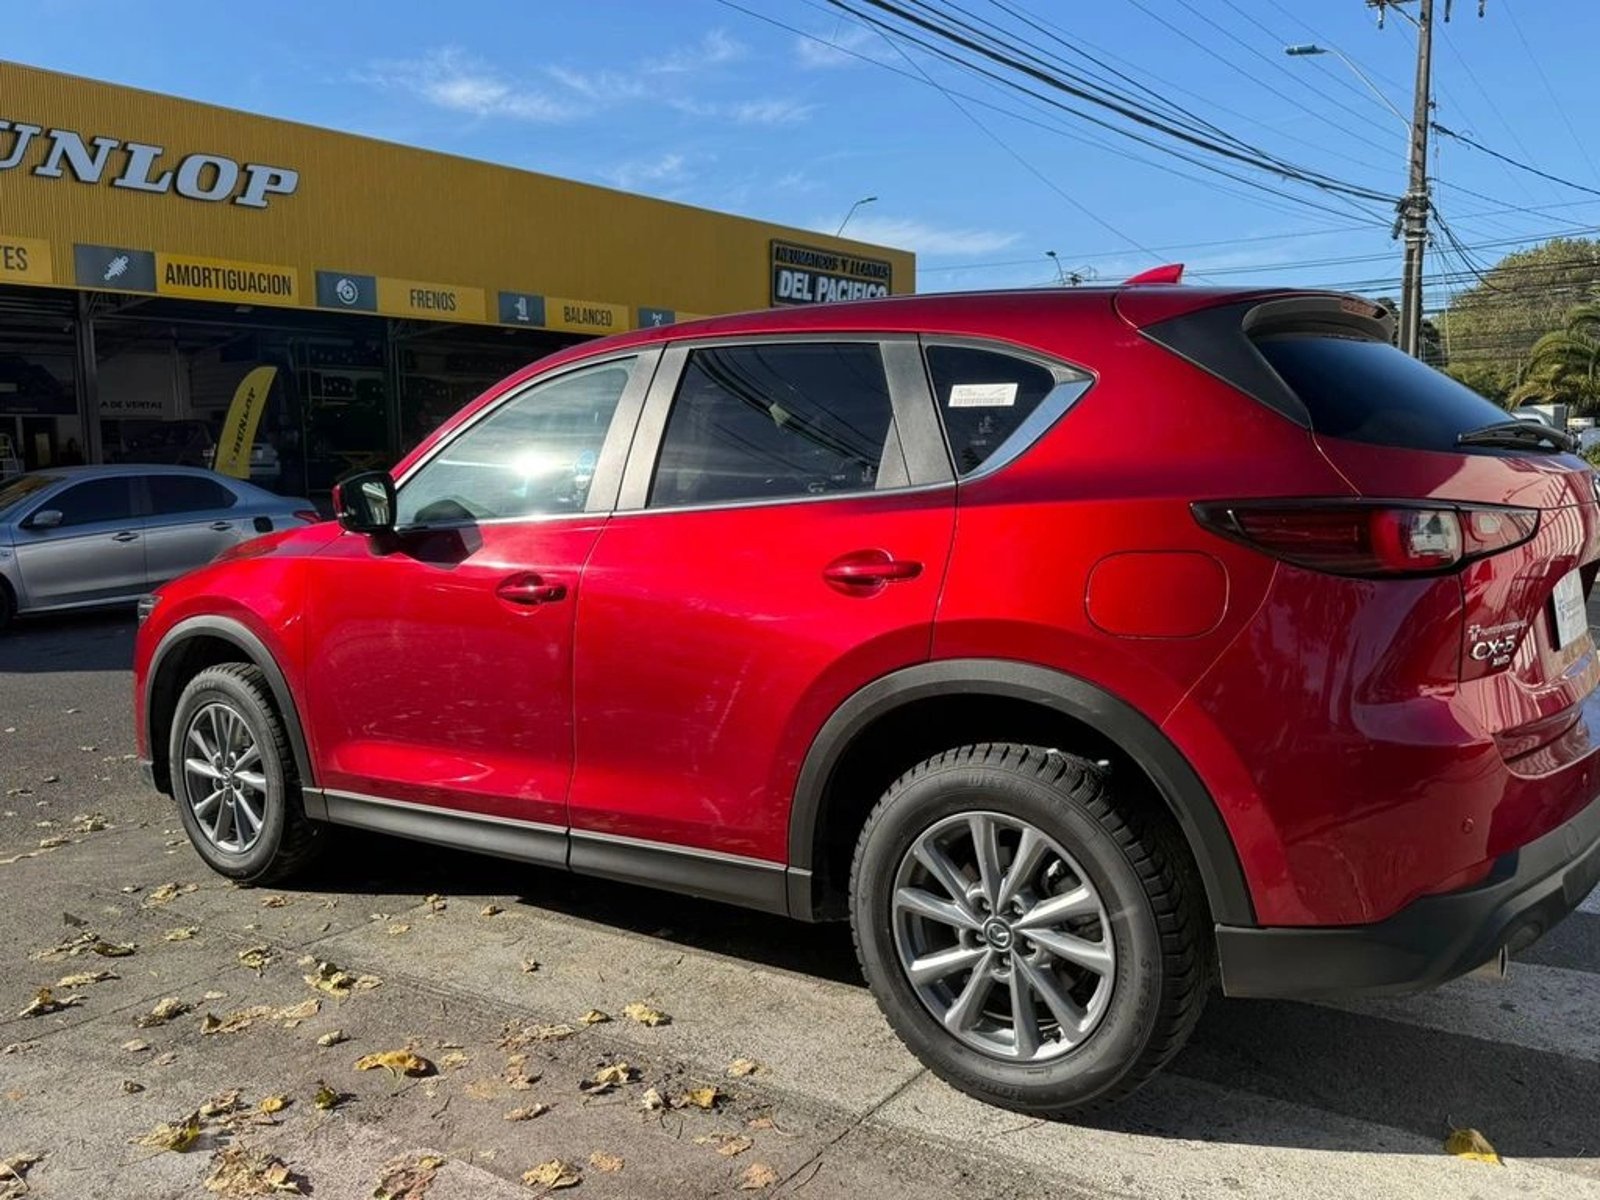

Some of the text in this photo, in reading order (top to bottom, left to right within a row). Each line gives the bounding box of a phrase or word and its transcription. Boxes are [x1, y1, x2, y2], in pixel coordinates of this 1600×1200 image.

[0, 119, 299, 208] UNLOP
[0, 245, 28, 271] ES
[841, 257, 850, 272] Y
[165, 262, 292, 296] AMORTIGUACION
[778, 270, 812, 300] DEL
[410, 288, 456, 311] FRENOS
[564, 306, 612, 327] BALANCEO
[1472, 635, 1515, 660] CX-5
